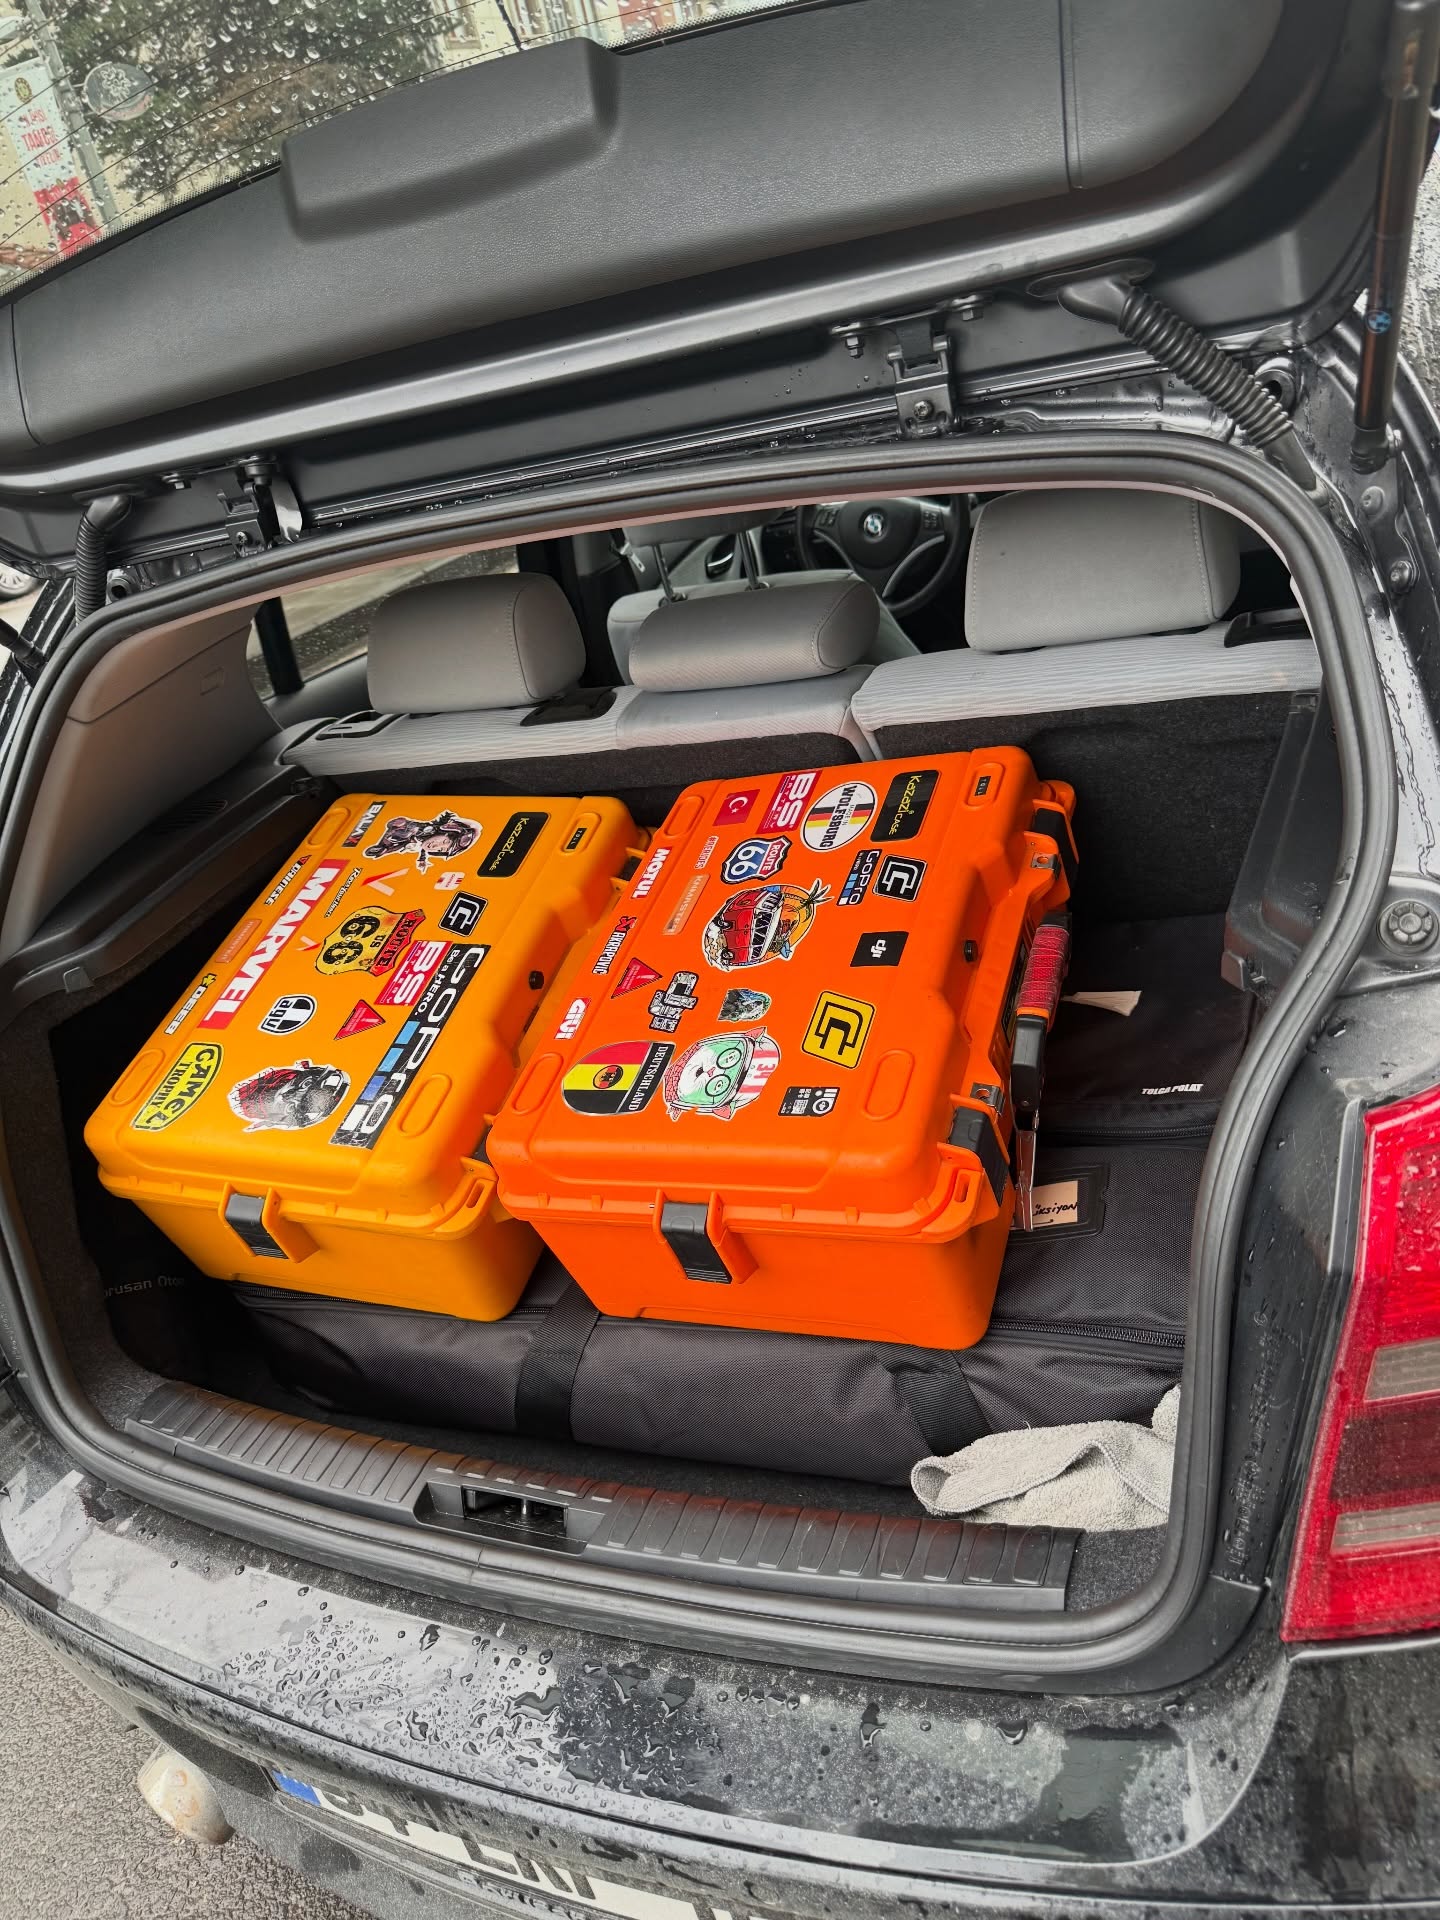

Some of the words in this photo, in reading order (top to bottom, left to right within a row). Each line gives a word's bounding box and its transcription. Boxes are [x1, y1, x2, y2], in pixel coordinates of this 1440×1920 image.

[776, 773, 816, 827] BS
[820, 785, 857, 848] WOLFSBURG
[632, 848, 671, 899] MOTUL
[730, 842, 766, 876] 66
[762, 844, 783, 871] ROUTE
[849, 851, 879, 904] GoPro
[203, 867, 340, 1021] MARVEL
[323, 915, 380, 965] 66
[370, 935, 386, 948] US
[378, 918, 416, 967] ROUTE
[447, 949, 460, 964] Be
[394, 941, 445, 1004] BS
[361, 947, 485, 1134] GoPro
[555, 998, 586, 1039] GIVI
[146, 1048, 215, 1124] CAMEL
[151, 1061, 193, 1108] TROPHY
[628, 1046, 669, 1111] DEUTSCHLAND
[753, 1063, 776, 1079] 34
